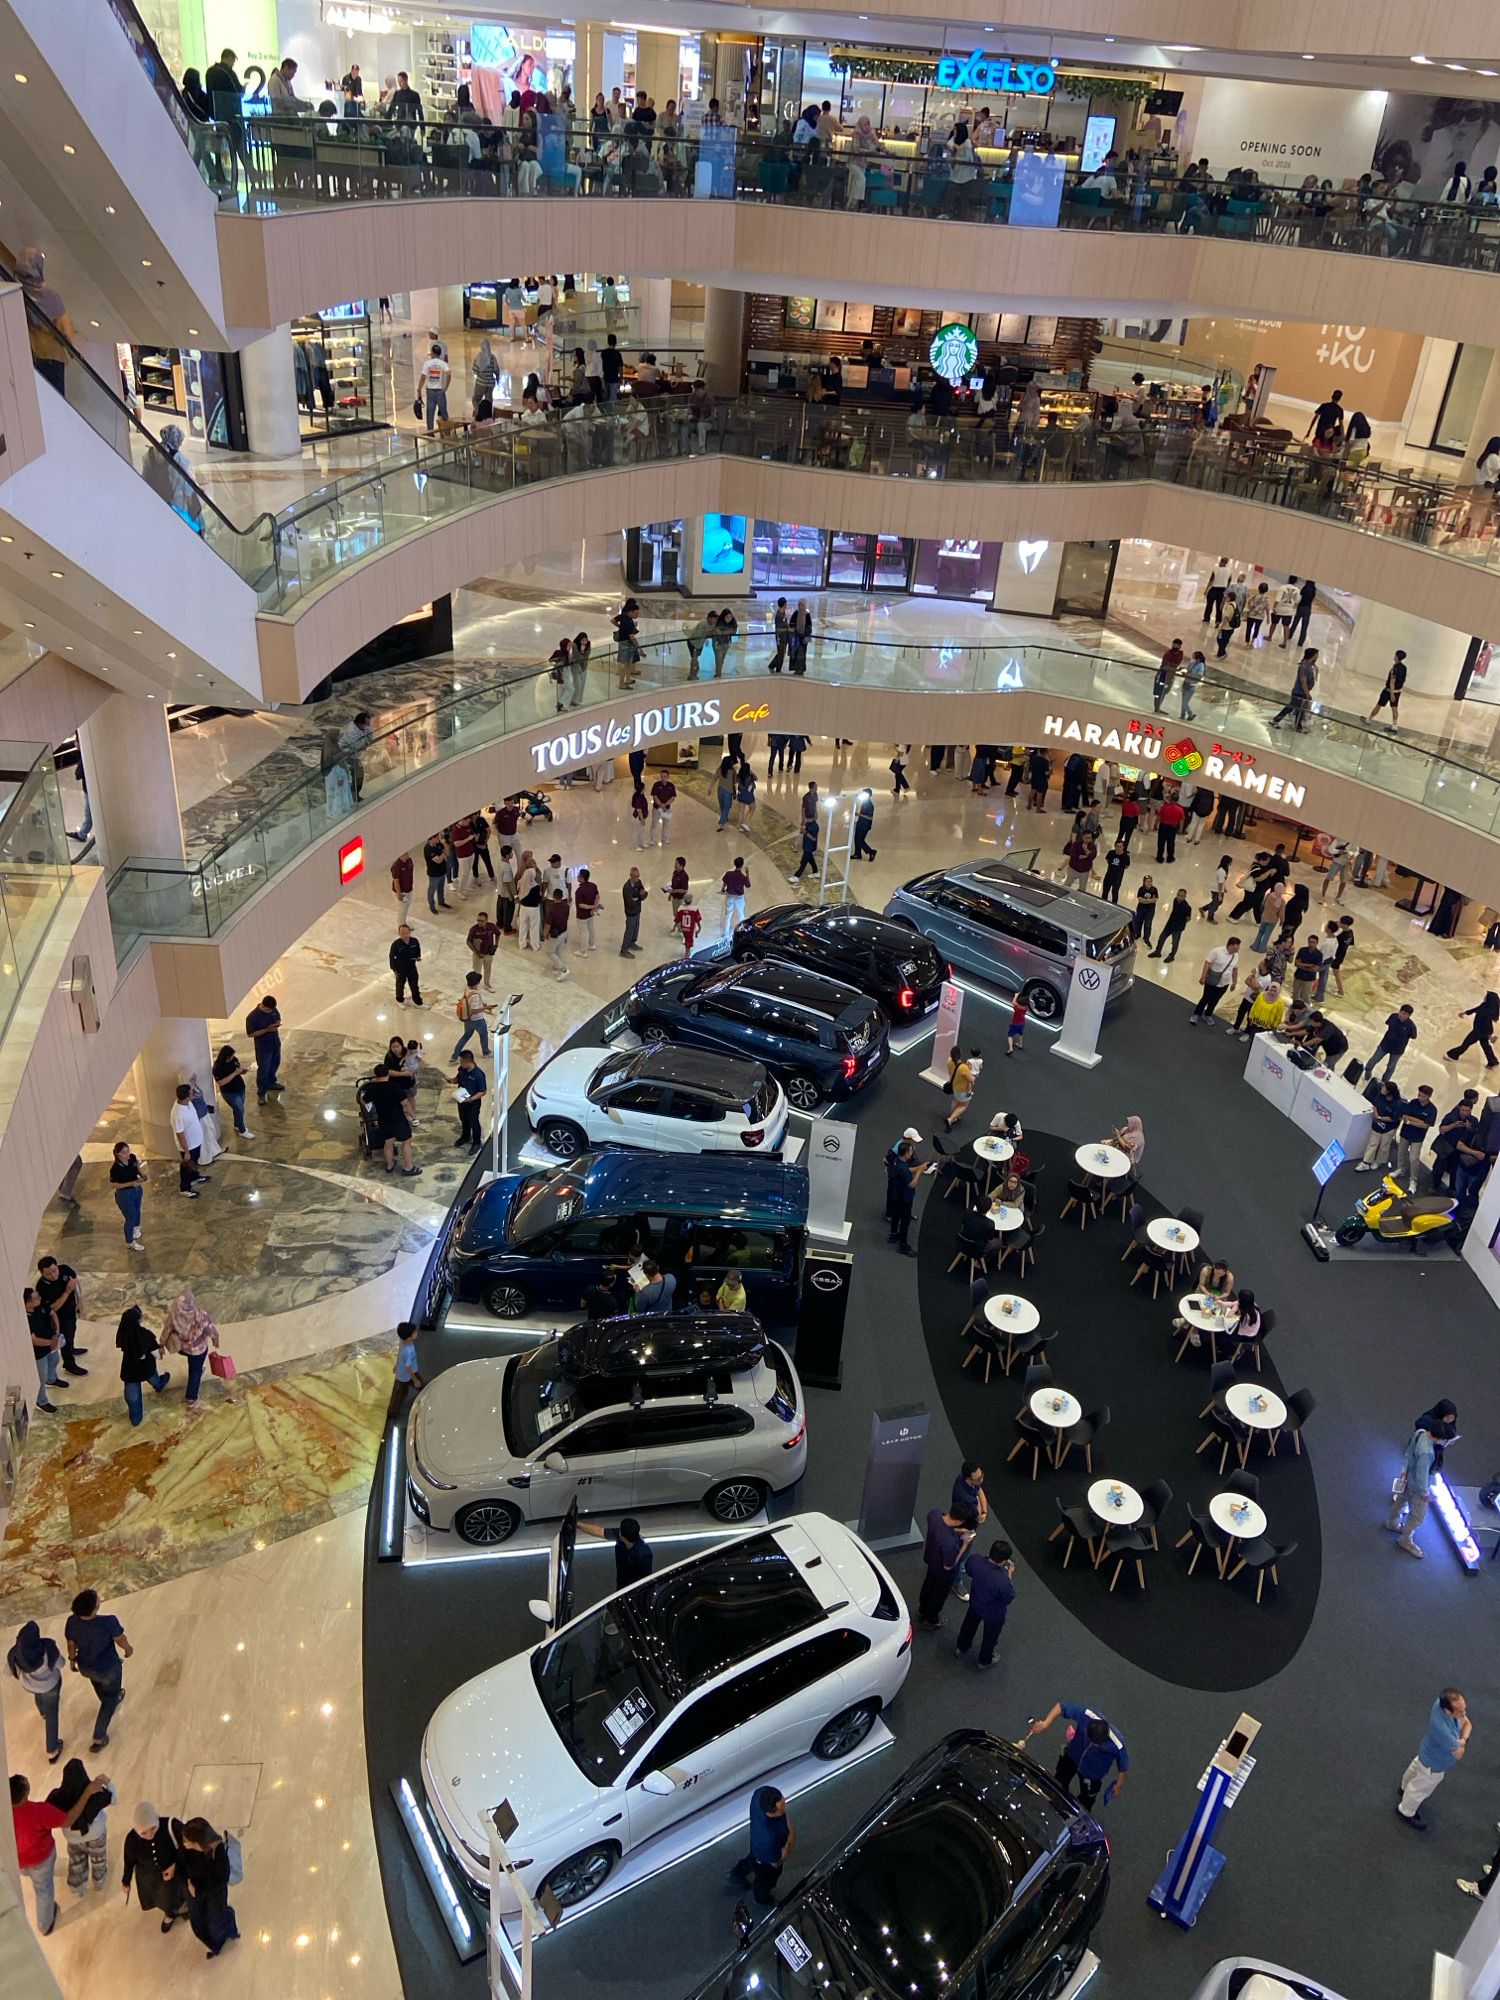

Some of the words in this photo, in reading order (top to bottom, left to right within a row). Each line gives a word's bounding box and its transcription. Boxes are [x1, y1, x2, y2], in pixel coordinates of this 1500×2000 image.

[937, 48, 1055, 94] EXCELSO
[1240, 141, 1287, 155] OPENING
[1290, 145, 1322, 157] SOON
[531, 725, 601, 773] TOUS
[606, 719, 631, 747] les
[632, 699, 721, 747] JOURS
[732, 703, 770, 723] Café
[1128, 719, 1165, 737] はらく
[1044, 715, 1162, 759] HARAKU
[1211, 743, 1256, 765] ラーメン
[1204, 755, 1307, 808] RAMEN
[682, 914, 691, 928] 10
[942, 1003, 957, 1015] GAC
[811, 1275, 843, 1286] NISSAN
[624, 1699, 636, 1715] 608
[637, 1697, 647, 1709] C10
[683, 1774, 698, 1790] #1
